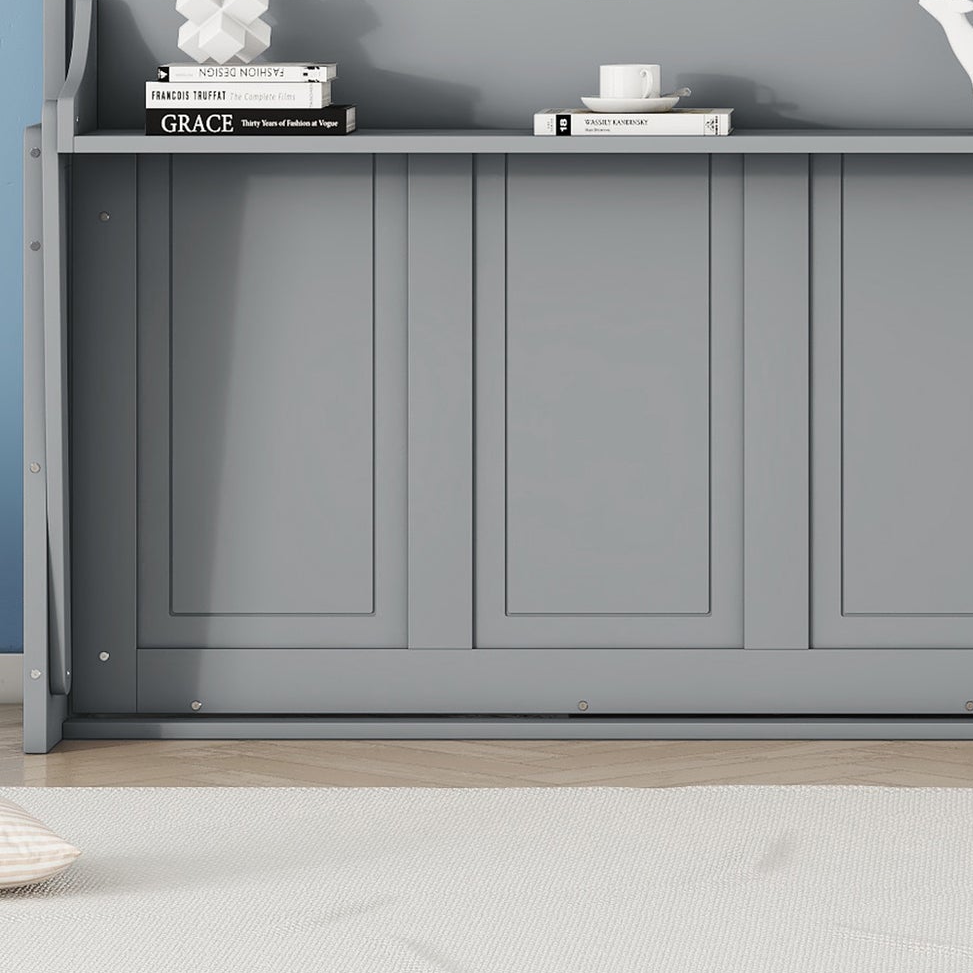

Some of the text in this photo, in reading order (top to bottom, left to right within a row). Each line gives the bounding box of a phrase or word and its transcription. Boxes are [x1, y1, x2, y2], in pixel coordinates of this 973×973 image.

[199, 67, 284, 78] FASHION DESIGN
[151, 90, 227, 101] FRANCOIS TRUFFAT
[161, 114, 234, 133] GRACE
[241, 119, 260, 129] Thirty
[261, 119, 278, 127] Years
[278, 119, 286, 127] of
[286, 119, 311, 127] Fashion
[318, 119, 339, 129] Vogue
[559, 118, 568, 132] 18
